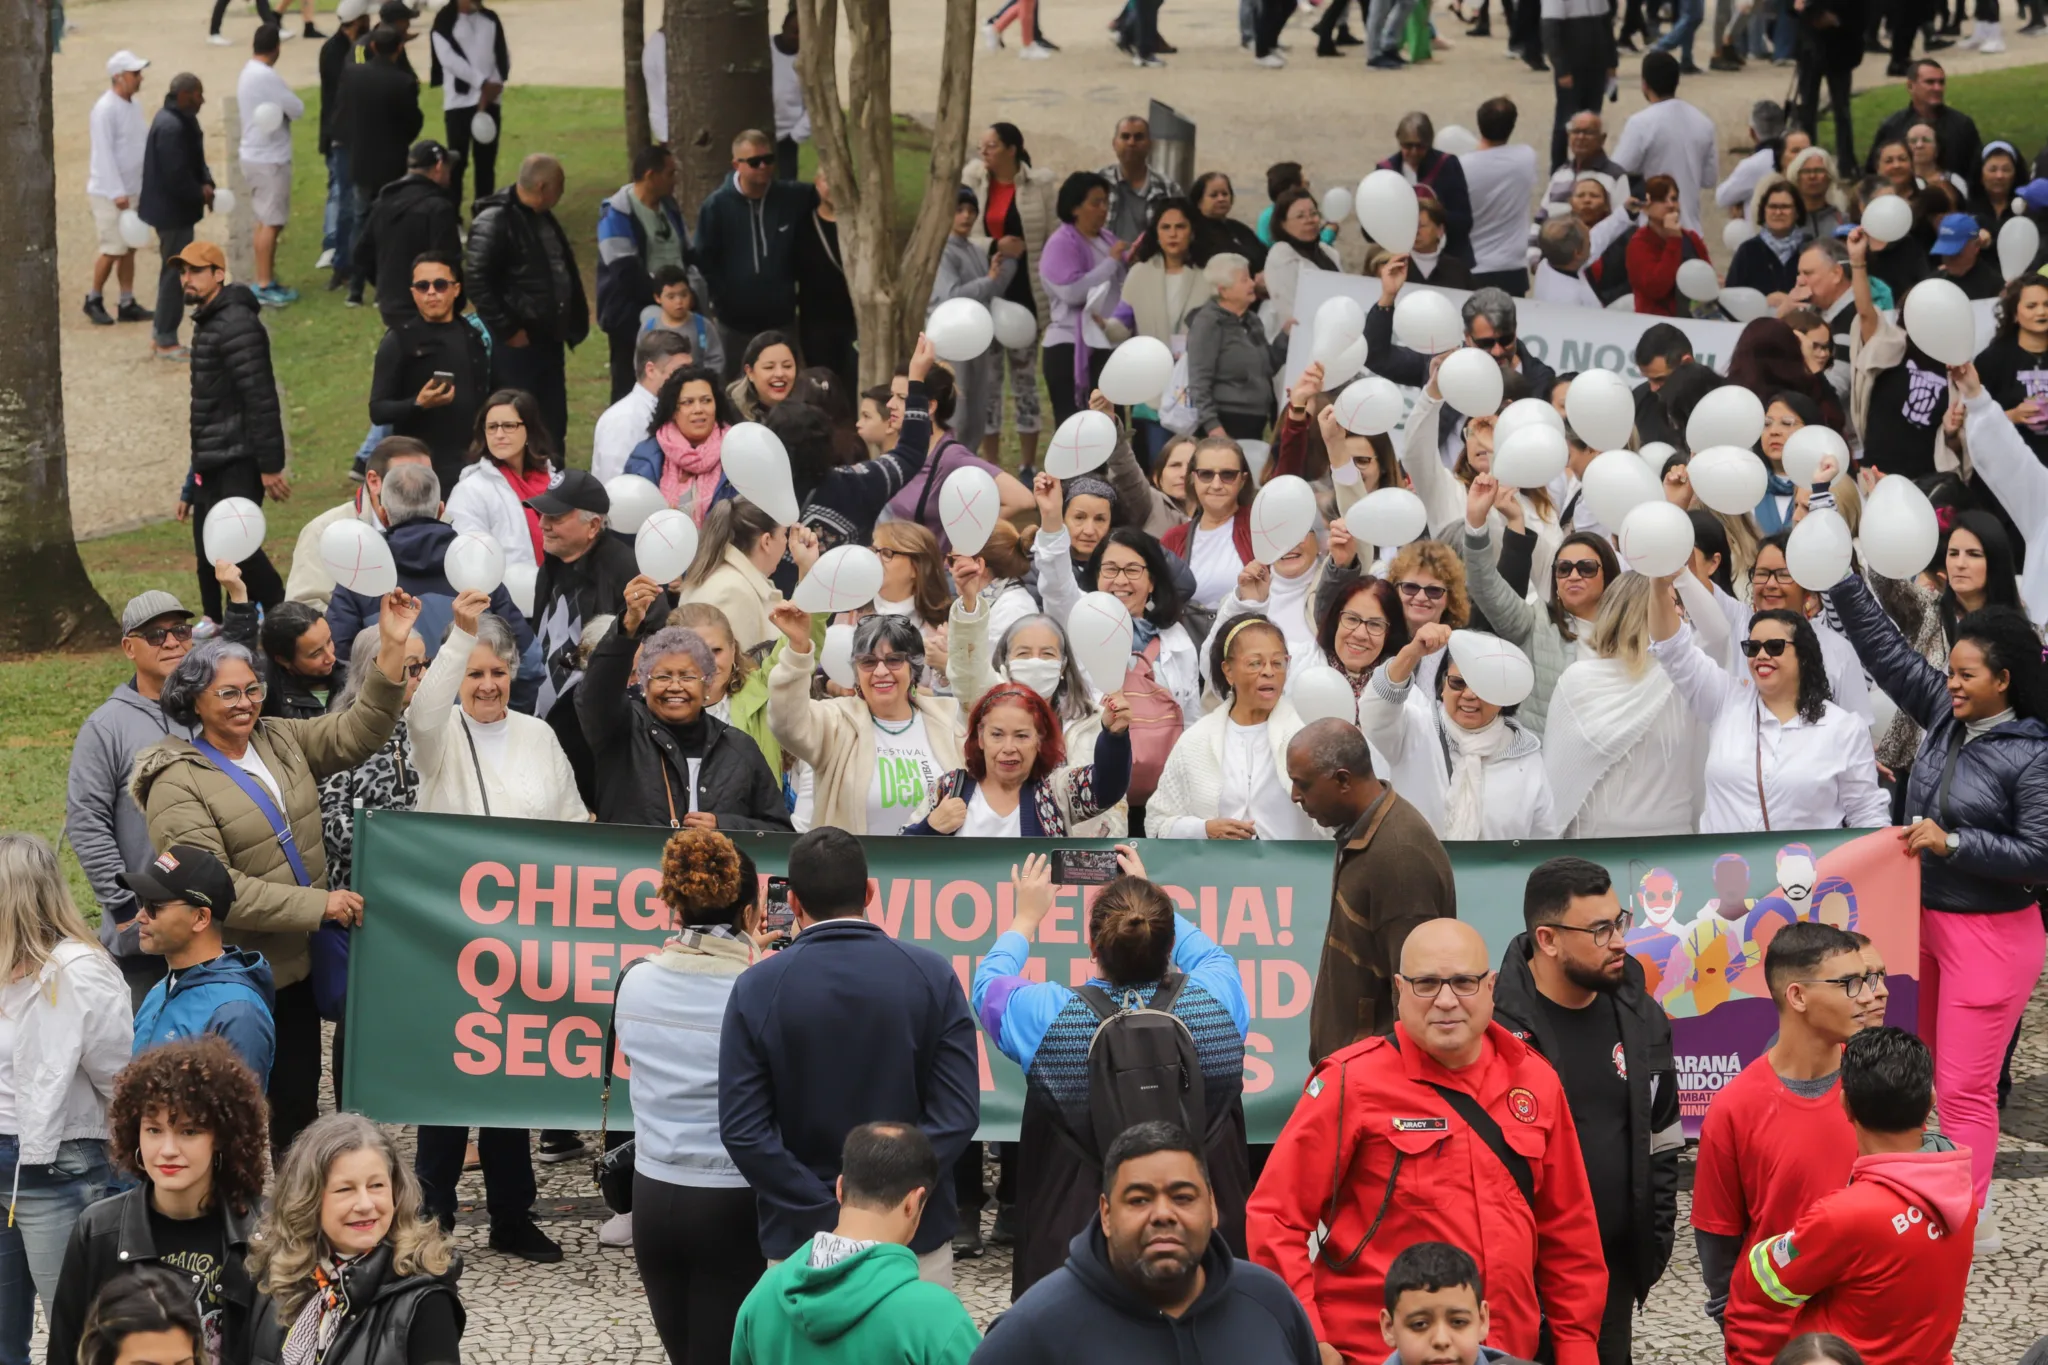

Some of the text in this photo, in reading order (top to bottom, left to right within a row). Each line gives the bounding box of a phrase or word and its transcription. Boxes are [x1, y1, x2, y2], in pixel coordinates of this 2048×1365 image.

[877, 746, 928, 757] FESTIVAL
[459, 861, 683, 931] CHEG
[456, 937, 663, 1014] QUE
[453, 1011, 632, 1080] SEG
[1673, 1052, 1742, 1072] ARANÁ
[1676, 1073, 1721, 1090] NIDO
[1678, 1092, 1715, 1103] MBAT
